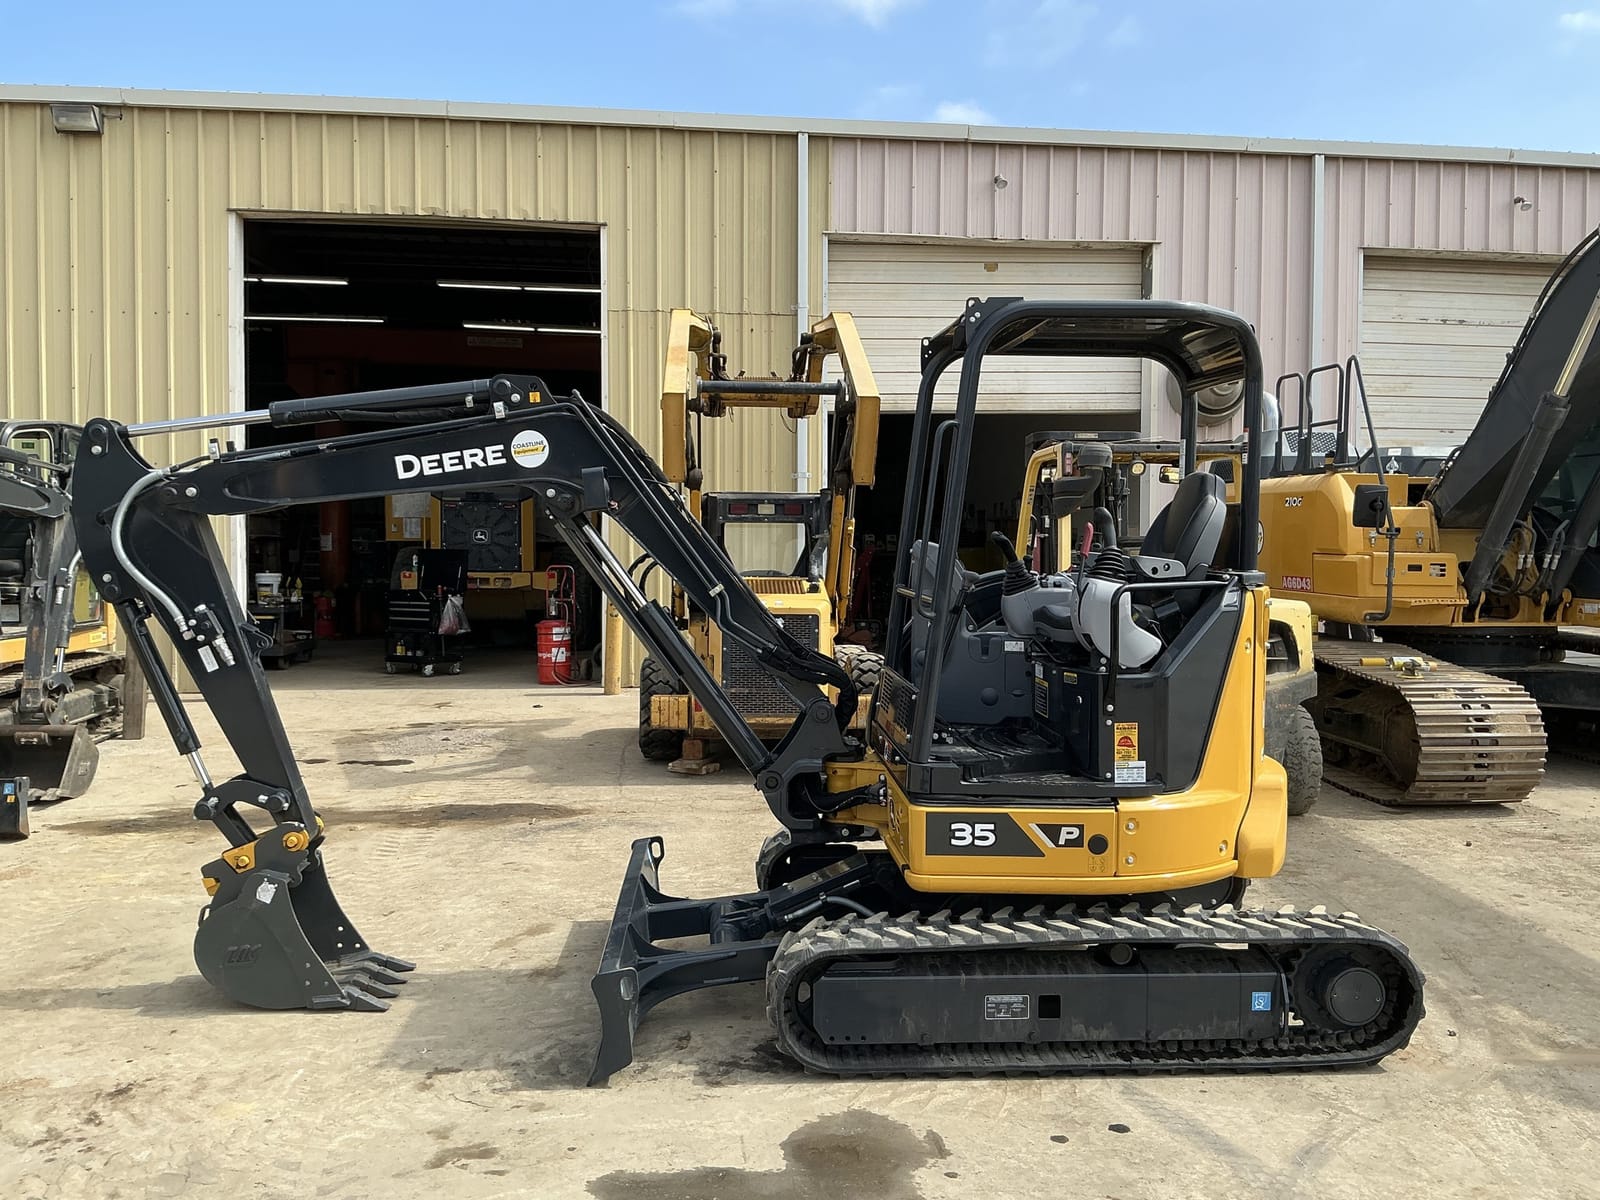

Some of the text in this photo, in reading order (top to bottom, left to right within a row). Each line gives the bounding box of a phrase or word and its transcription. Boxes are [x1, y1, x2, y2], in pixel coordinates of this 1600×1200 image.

[512, 440, 544, 450] COASTLINE
[394, 444, 507, 480] DEERE
[950, 822, 1080, 847] 35 P
